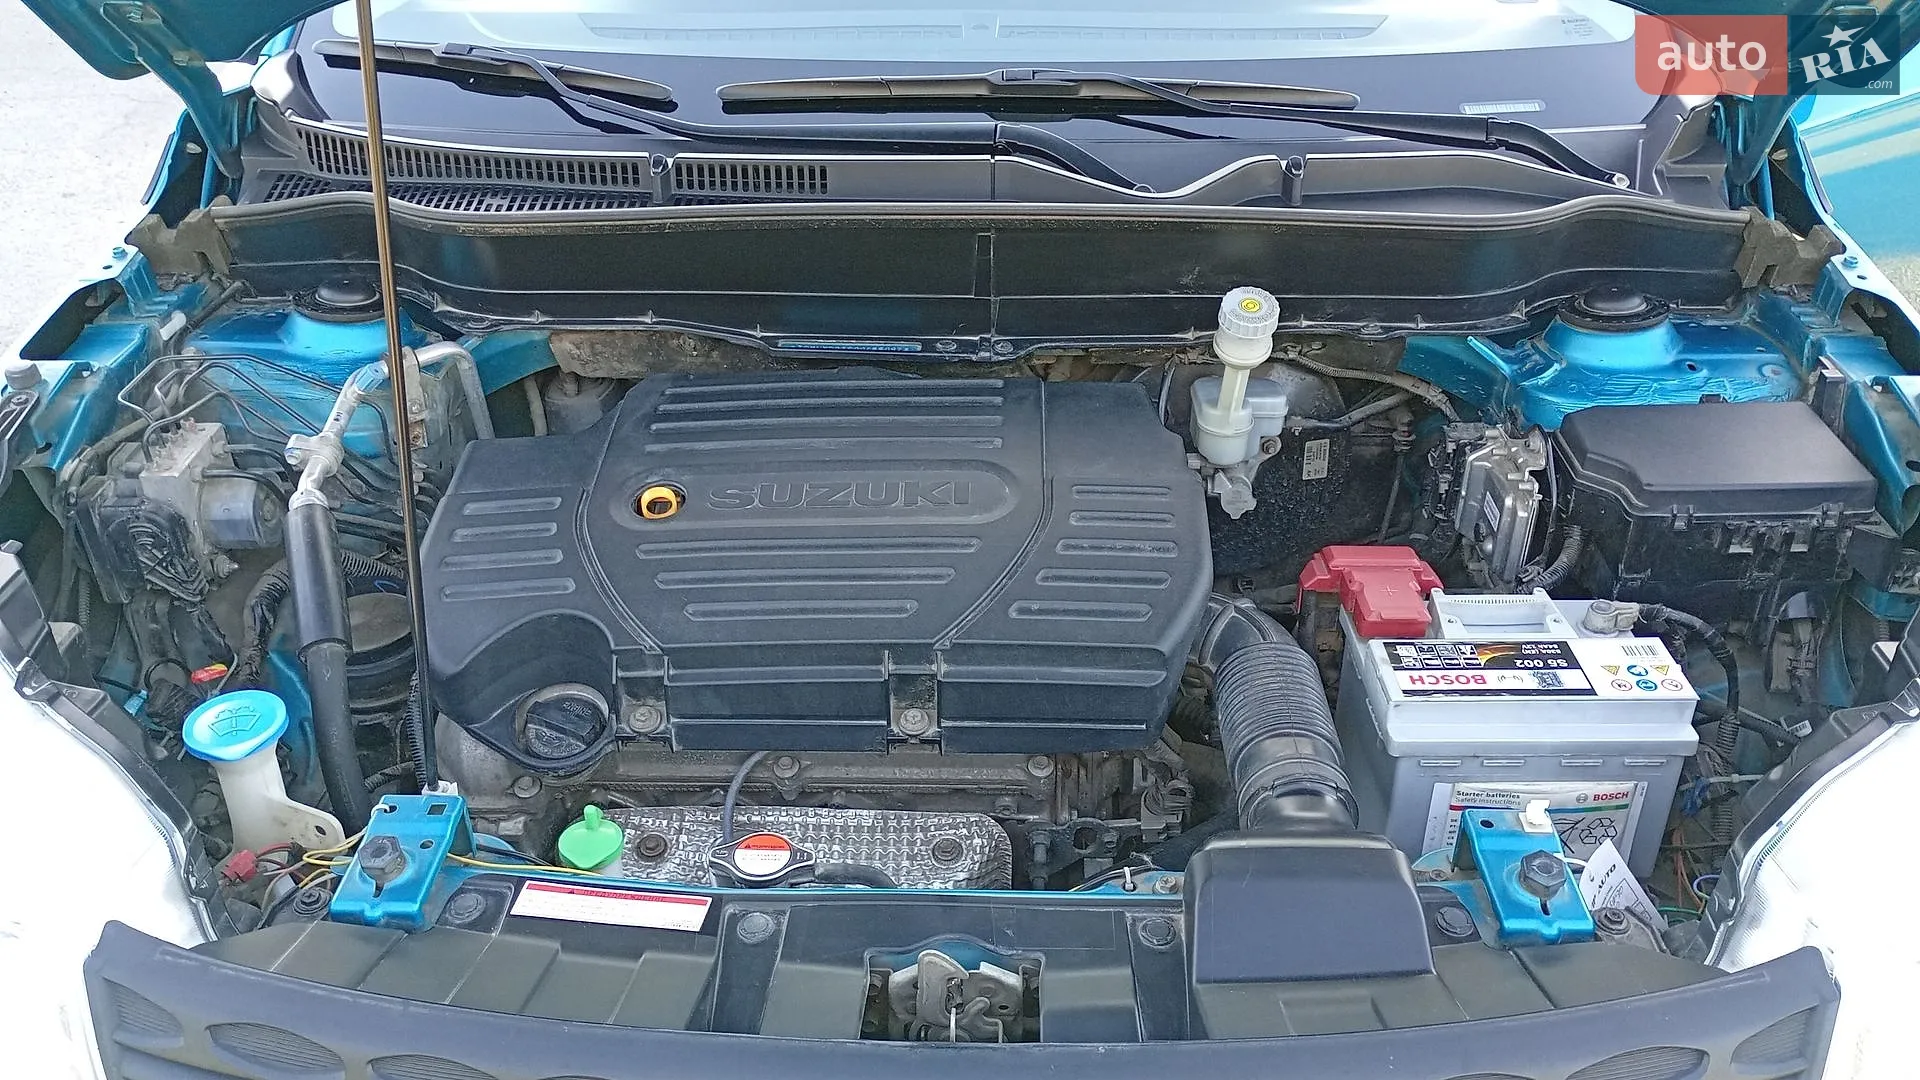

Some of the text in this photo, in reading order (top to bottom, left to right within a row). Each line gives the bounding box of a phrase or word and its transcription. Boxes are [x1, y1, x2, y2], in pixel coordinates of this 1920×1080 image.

[708, 481, 972, 510] SUZUKI
[1513, 659, 1568, 668] S5 002
[1408, 674, 1487, 685] BOSCH
[1456, 790, 1520, 799] Starter batteries
[1592, 791, 1630, 801] BOSCH
[1478, 798, 1522, 806] instructions
